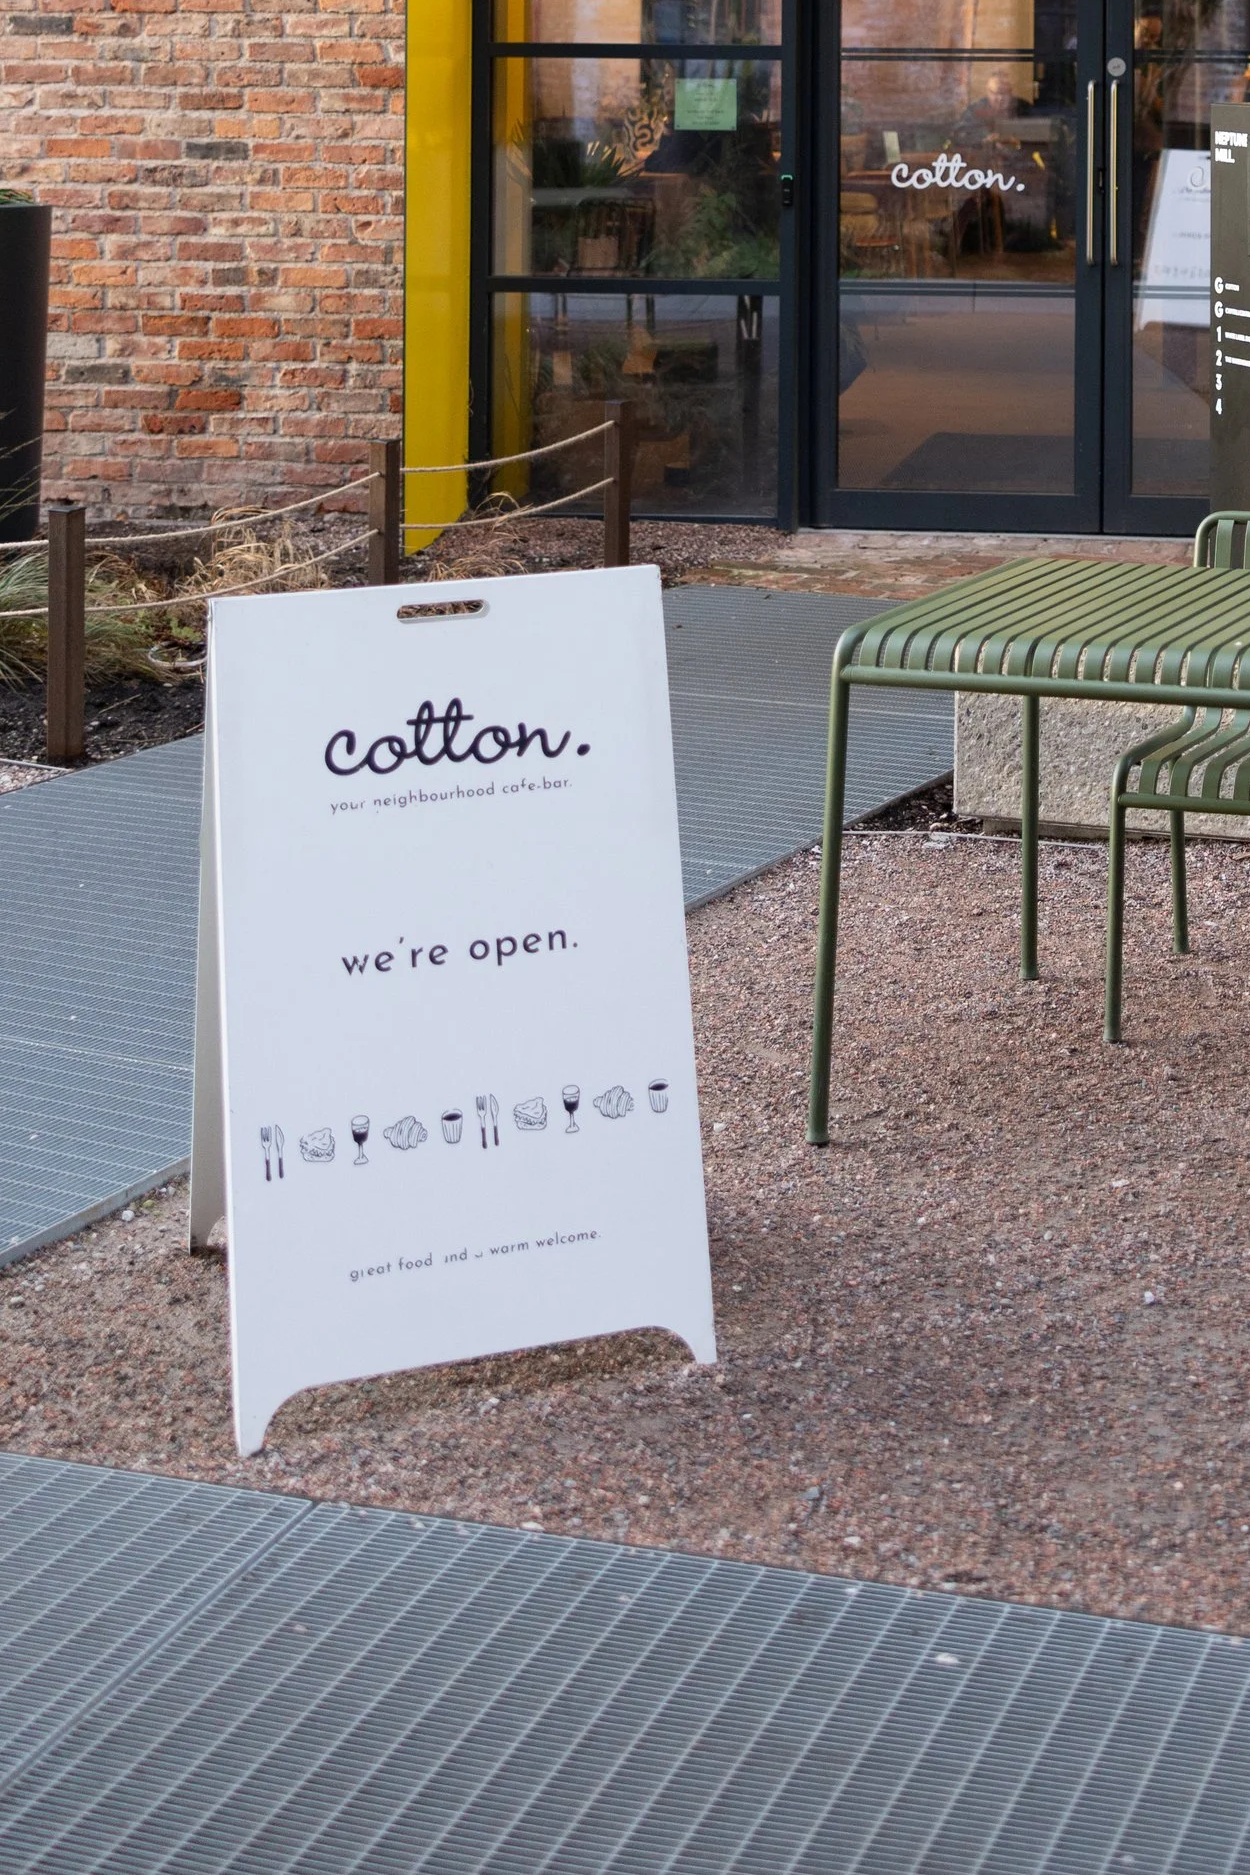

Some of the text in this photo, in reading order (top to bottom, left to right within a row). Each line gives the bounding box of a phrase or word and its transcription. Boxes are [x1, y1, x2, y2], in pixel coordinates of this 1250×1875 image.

[1214, 130, 1249, 148] NEPTUNE
[890, 152, 1026, 192] cotton.
[1214, 276, 1224, 294] G
[1214, 300, 1224, 318] G
[1216, 325, 1222, 343] 1
[1215, 349, 1223, 367] 2
[1215, 373, 1223, 391] 3
[1215, 398, 1223, 415] 4
[324, 697, 591, 777] cotton.
[330, 800, 366, 816] your
[373, 780, 495, 809] neighbourhood
[341, 929, 579, 976] we're open.
[398, 1252, 433, 1271] food
[489, 1241, 530, 1256] warm
[535, 1230, 602, 1248] welcome.
